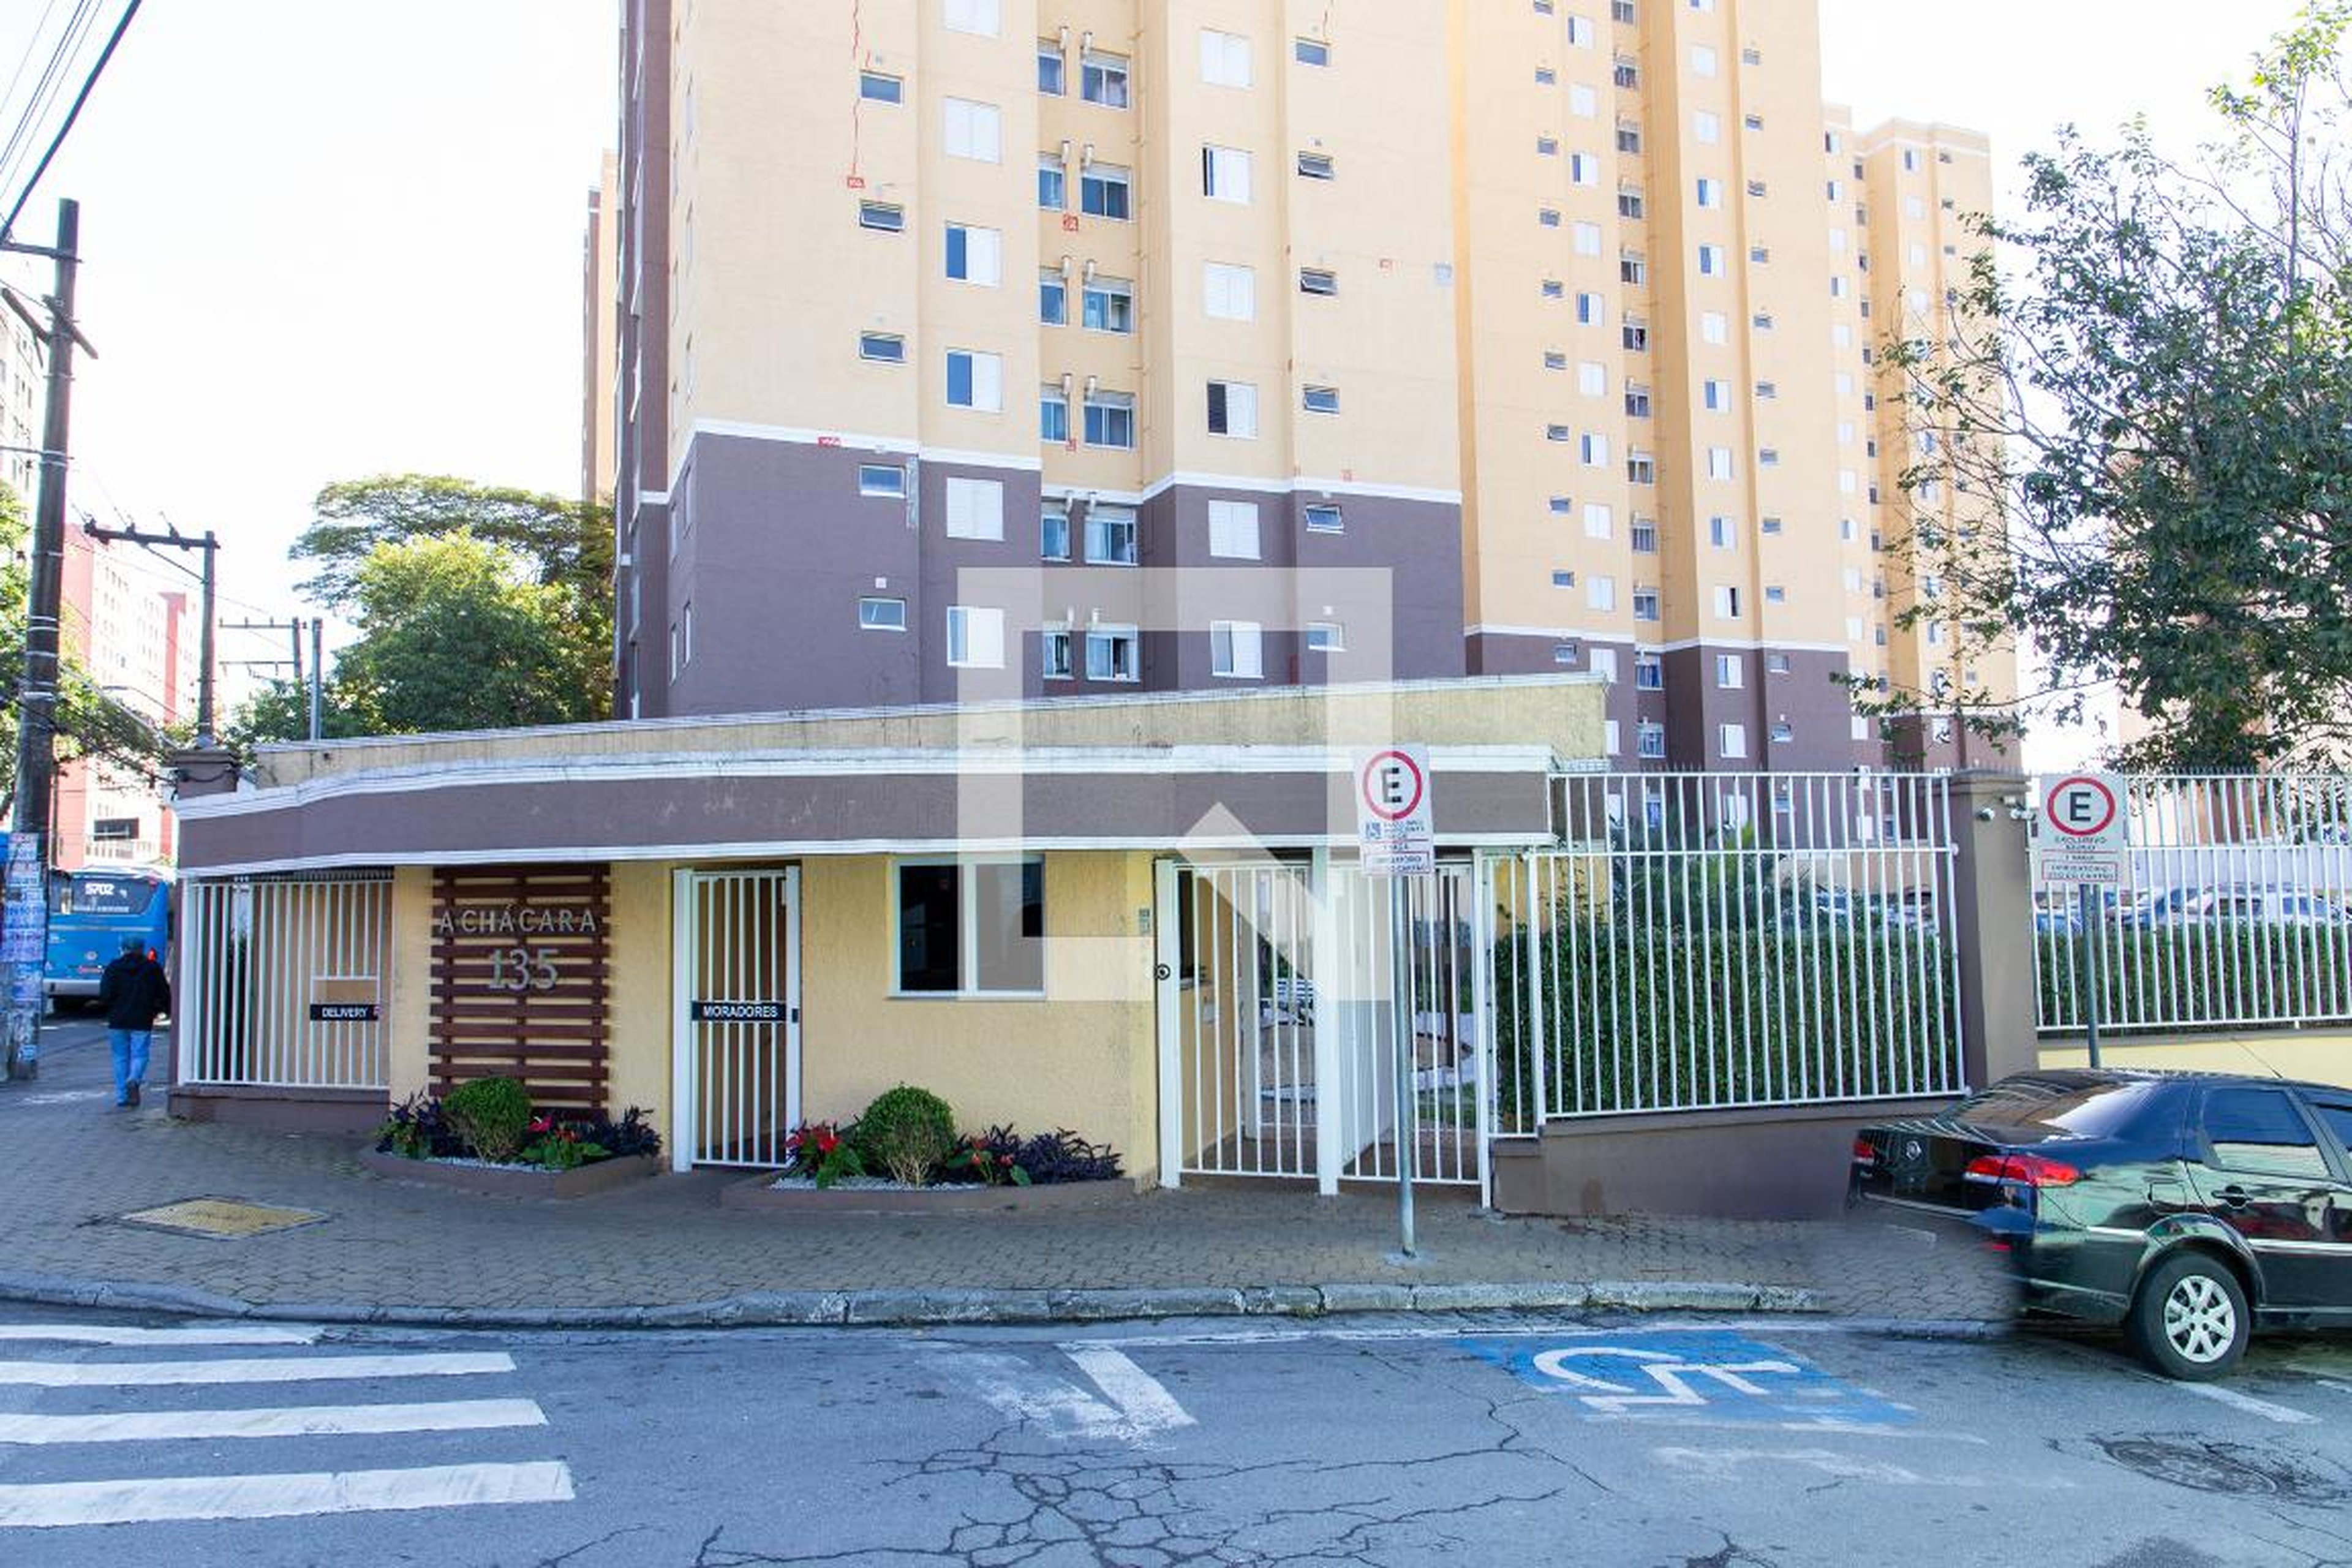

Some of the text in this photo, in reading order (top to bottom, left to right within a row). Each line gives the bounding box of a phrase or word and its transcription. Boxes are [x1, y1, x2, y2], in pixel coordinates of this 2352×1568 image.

[1381, 767, 1403, 803] E
[2070, 791, 2091, 822] E
[488, 947, 559, 991] 135
[322, 1006, 368, 1018] DELIVERY
[703, 1005, 778, 1018] MORADORES
